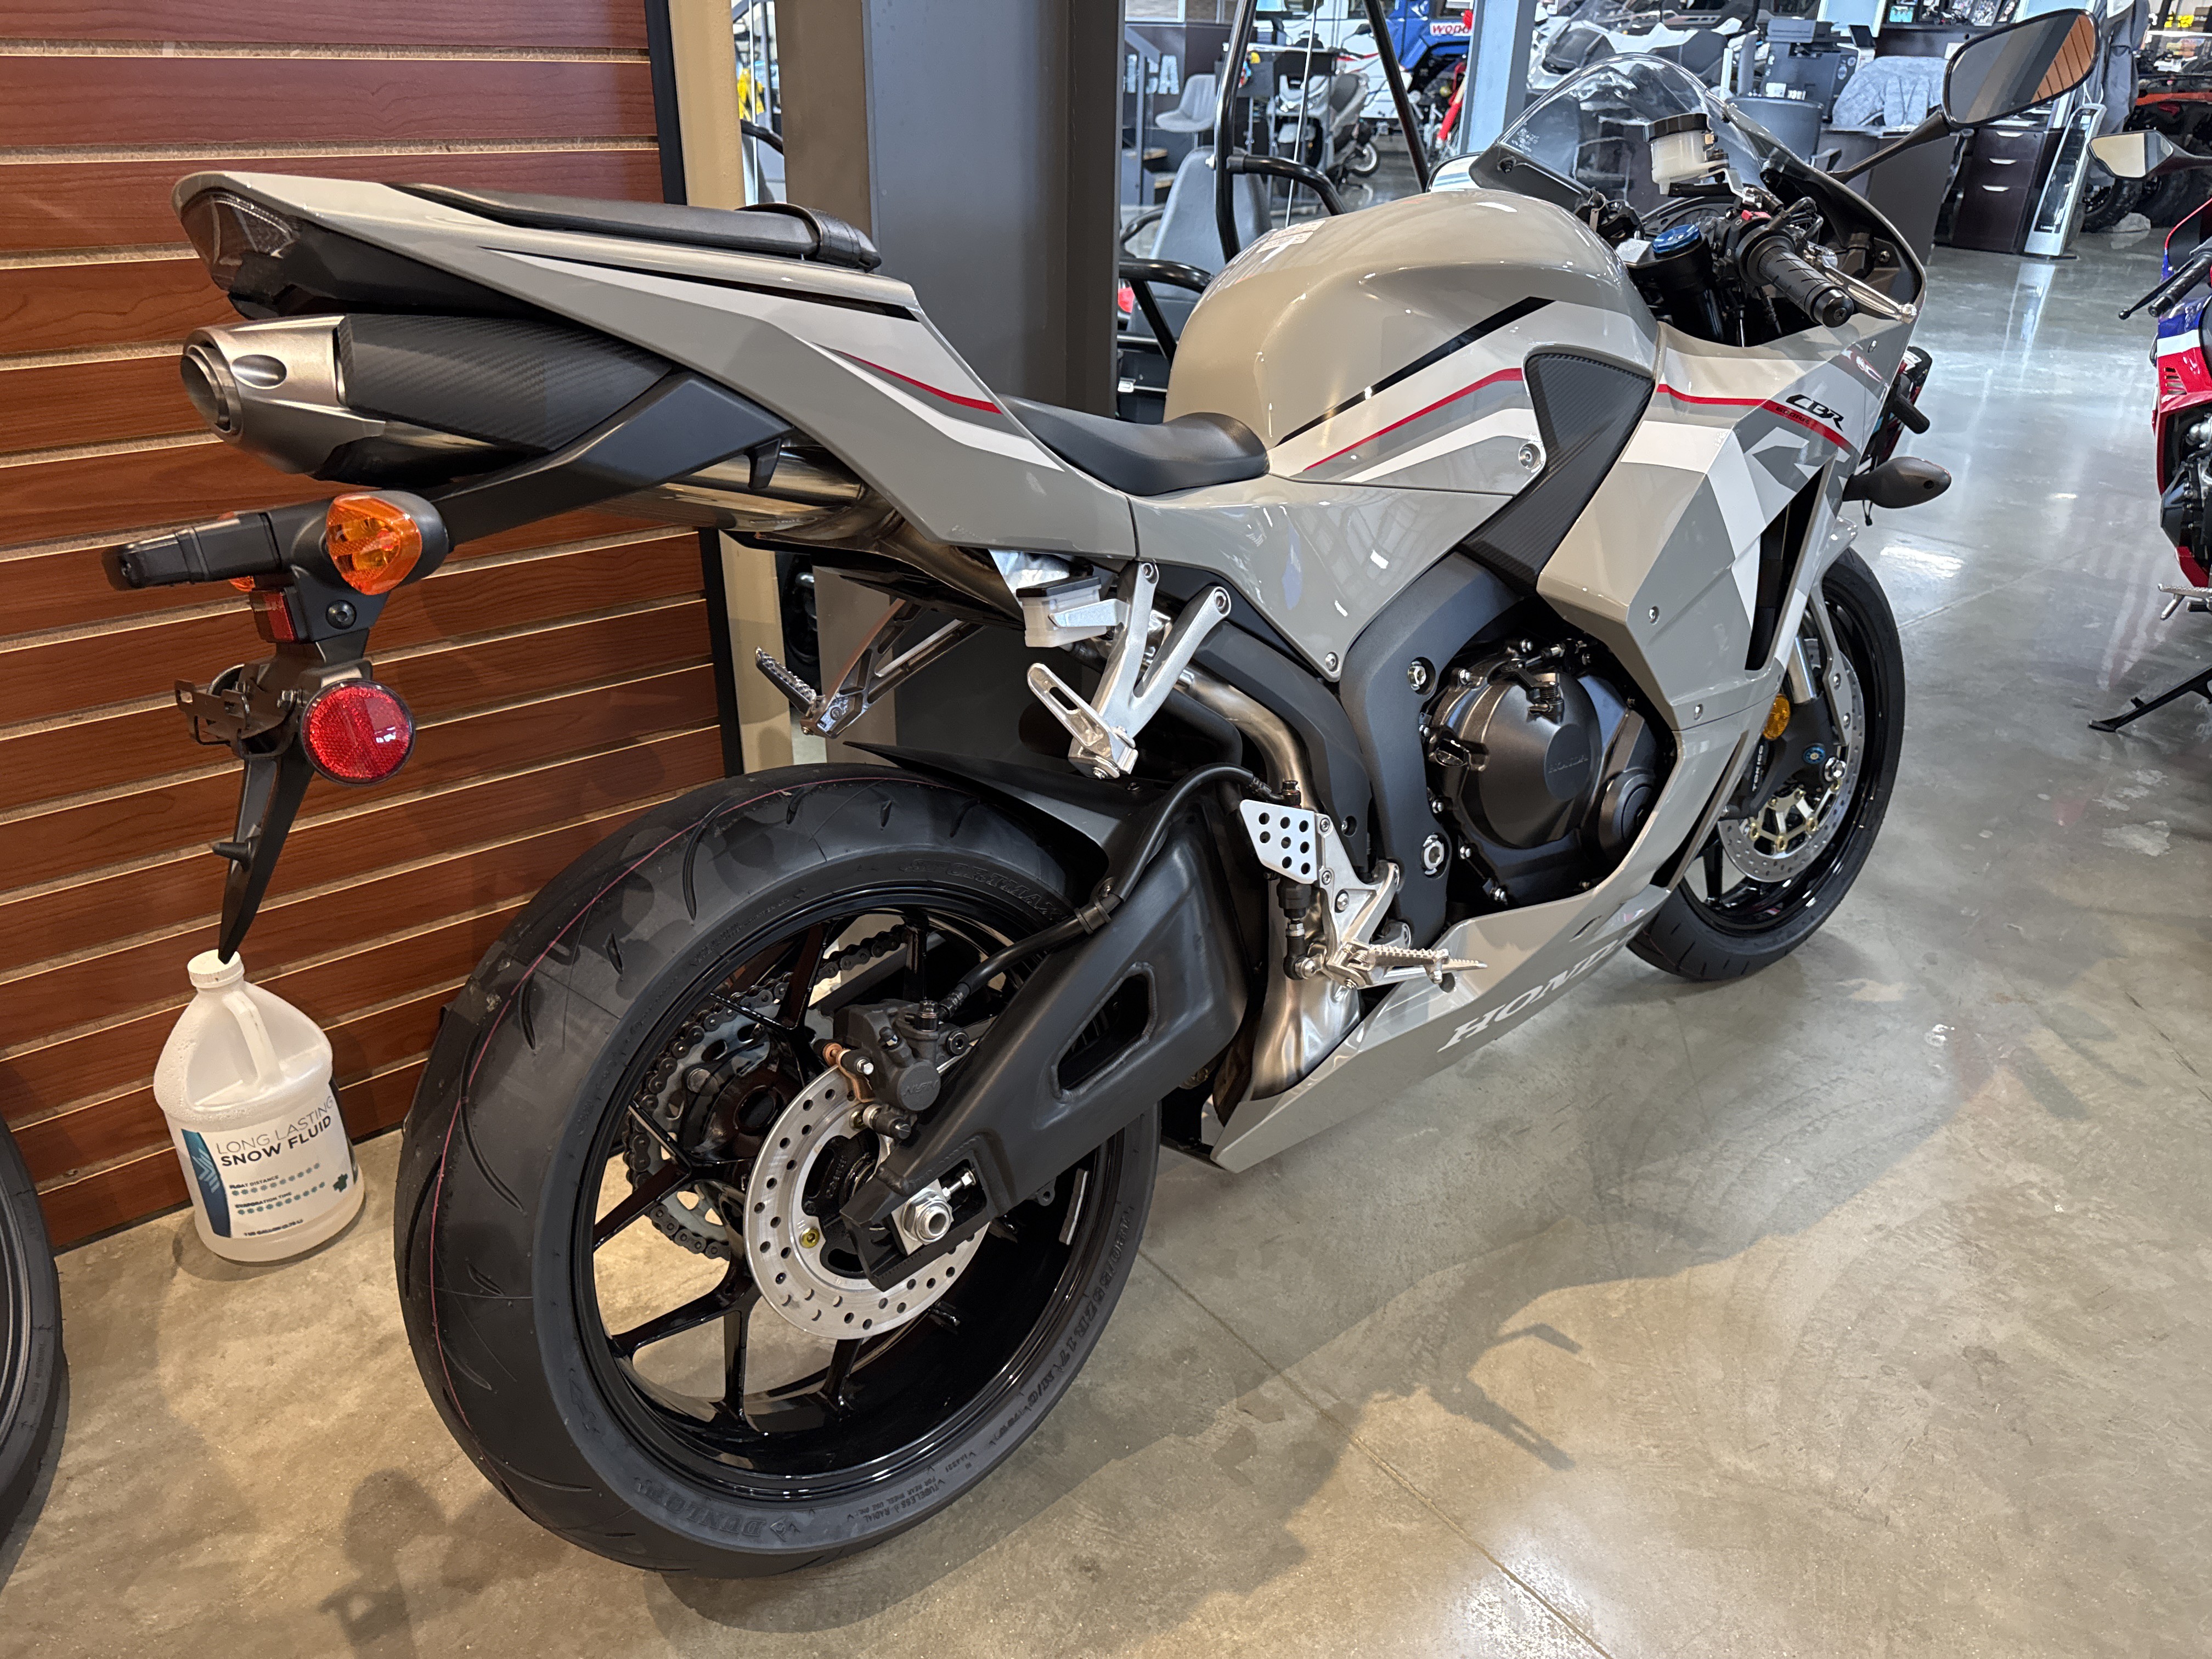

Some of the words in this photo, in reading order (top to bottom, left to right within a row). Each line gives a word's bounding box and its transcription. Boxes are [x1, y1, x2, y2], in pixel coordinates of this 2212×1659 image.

[1785, 394, 1844, 432] CBR
[1547, 754, 1589, 774] HONDA
[1752, 744, 1764, 792] TOKICO
[1437, 922, 1644, 1053] HONDA
[216, 1133, 270, 1155] LONG
[275, 1096, 333, 1141] LASTING
[221, 1143, 281, 1166] SNOW
[288, 1115, 331, 1149] FLUID
[250, 1175, 279, 1187] DISTANCE
[862, 1506, 890, 1523] RADIAL
